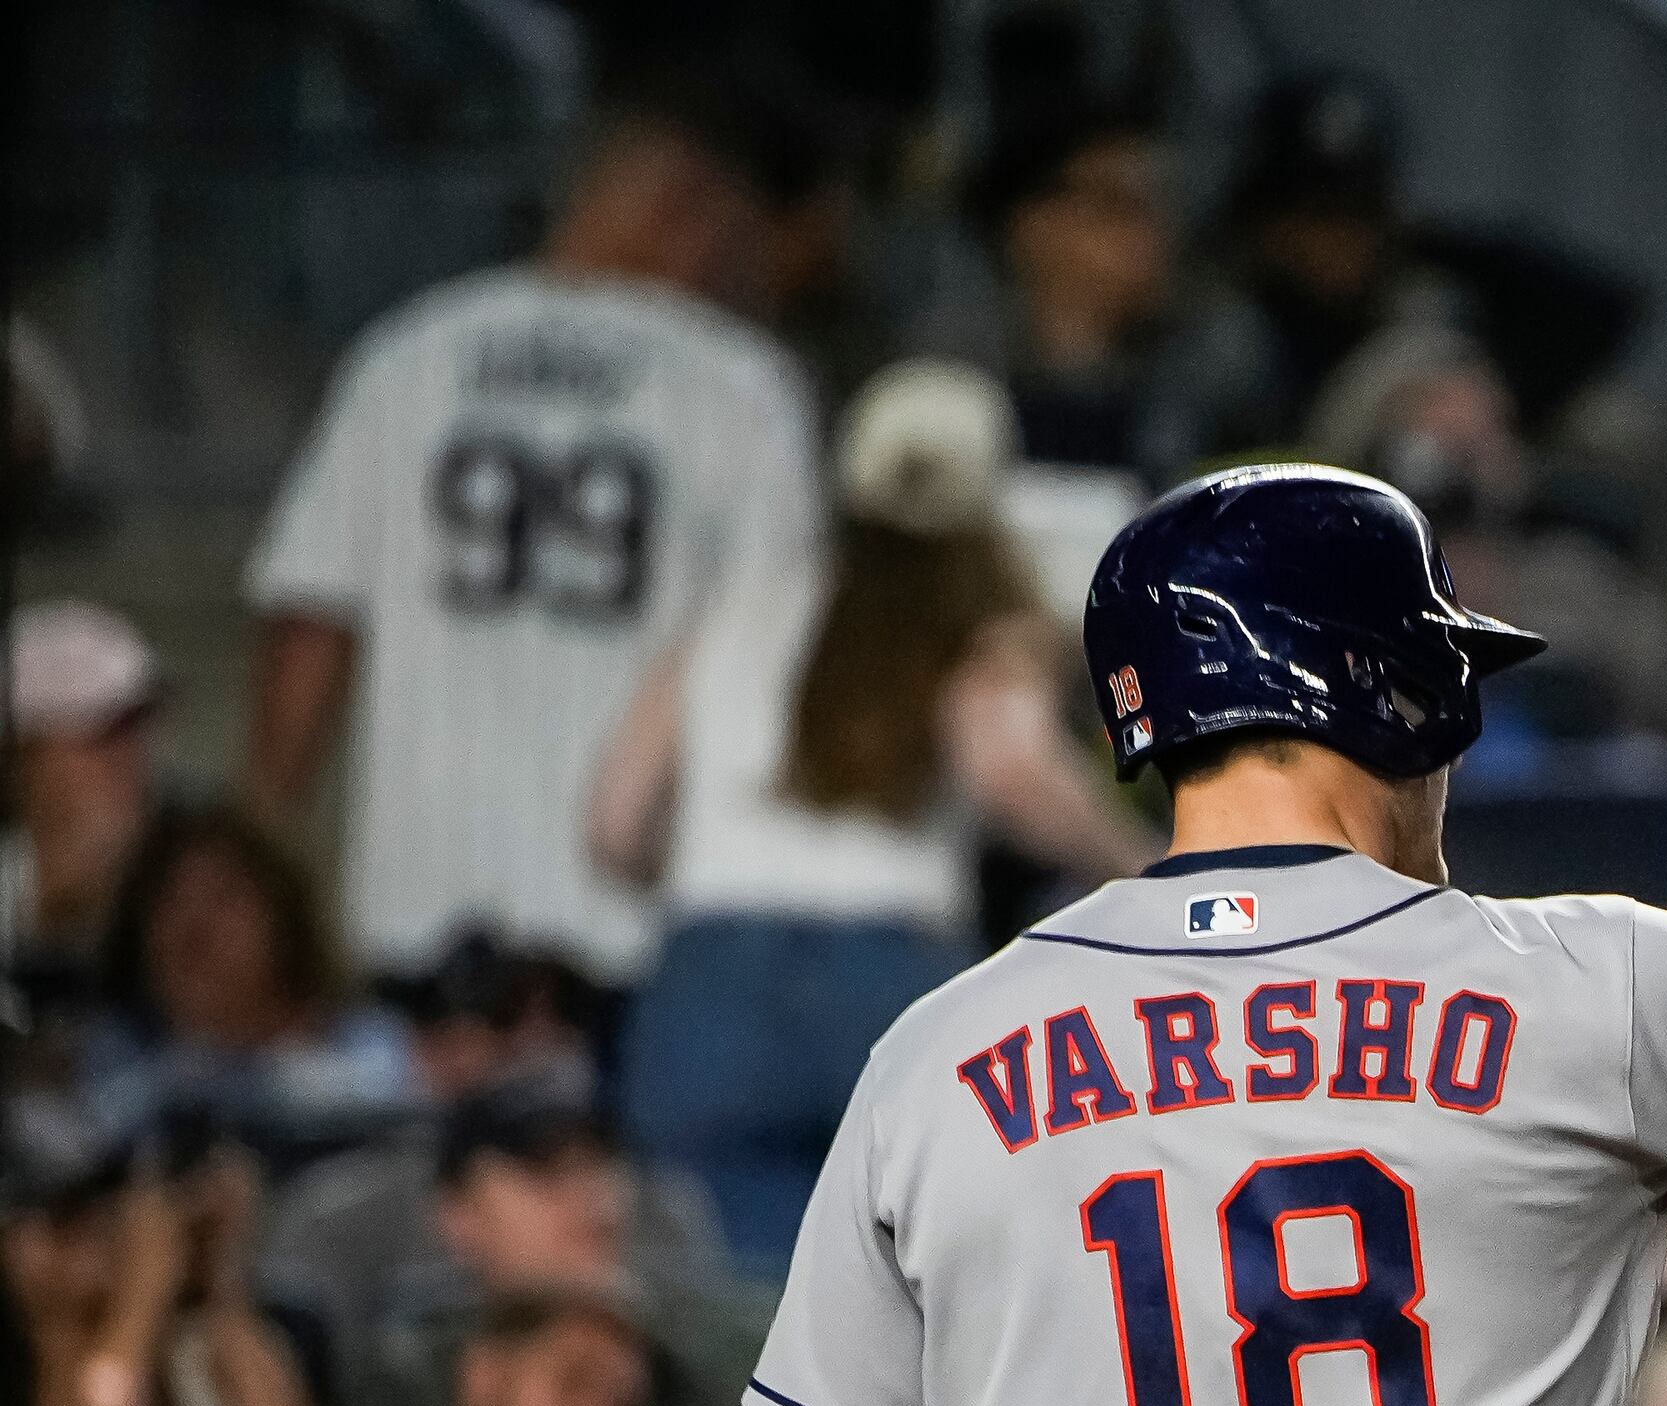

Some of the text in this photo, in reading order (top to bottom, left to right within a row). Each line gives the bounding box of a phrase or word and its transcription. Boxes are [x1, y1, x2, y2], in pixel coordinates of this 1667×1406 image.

[430, 436, 655, 624] 99
[1108, 664, 1144, 719] 18
[956, 979, 1518, 1154] VARSHO
